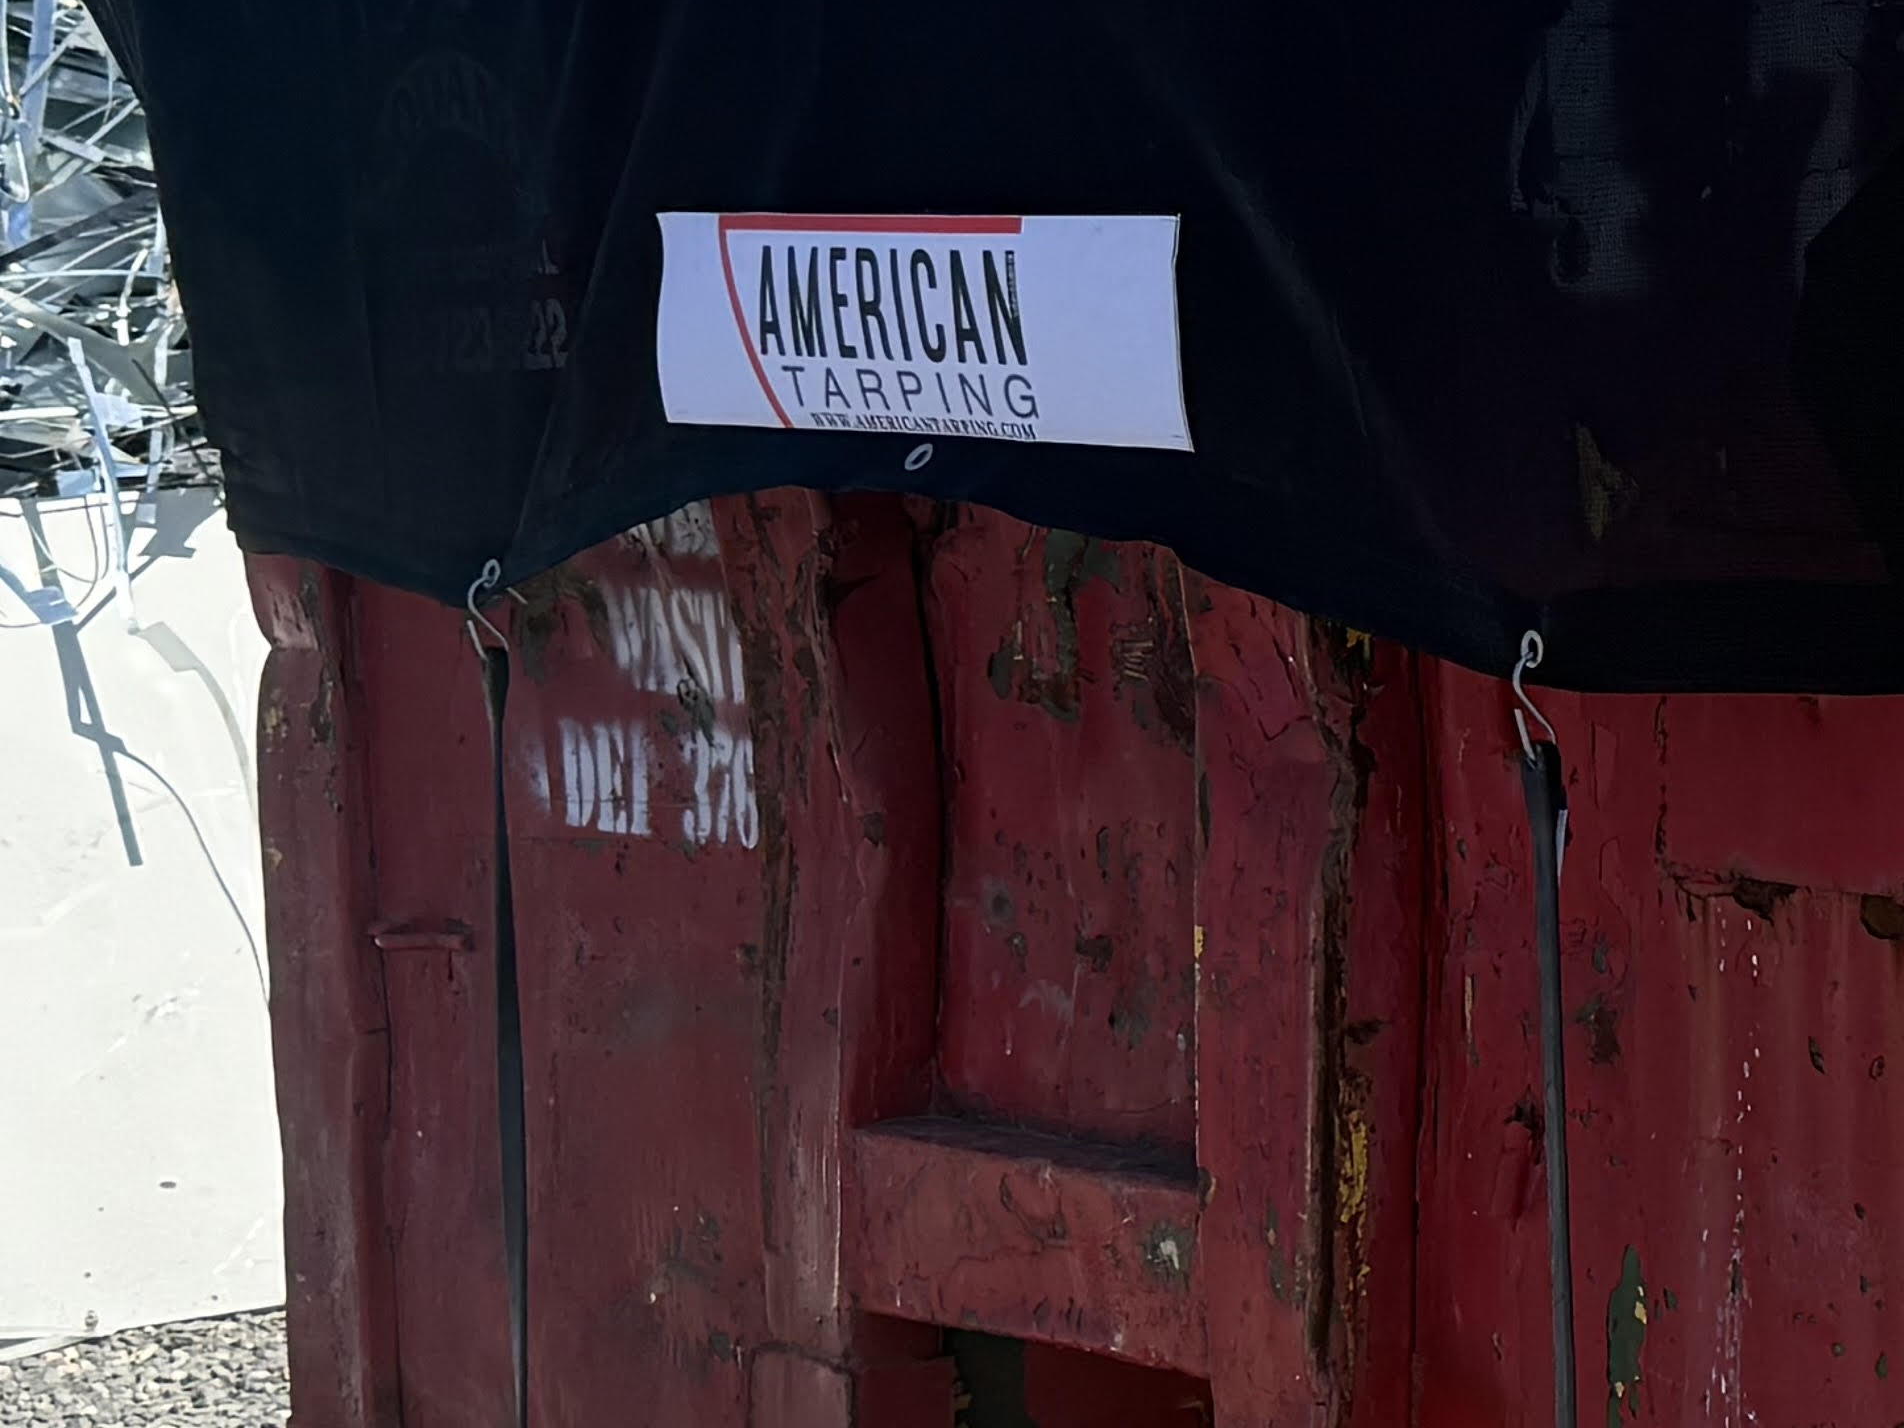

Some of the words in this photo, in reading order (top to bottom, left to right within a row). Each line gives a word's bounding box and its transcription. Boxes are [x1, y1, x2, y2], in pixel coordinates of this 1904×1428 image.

[758, 245, 1028, 366] AMERICAN
[781, 365, 1040, 419] TARPING
[810, 411, 1037, 441] WWW.AMERICANTARPING.COM
